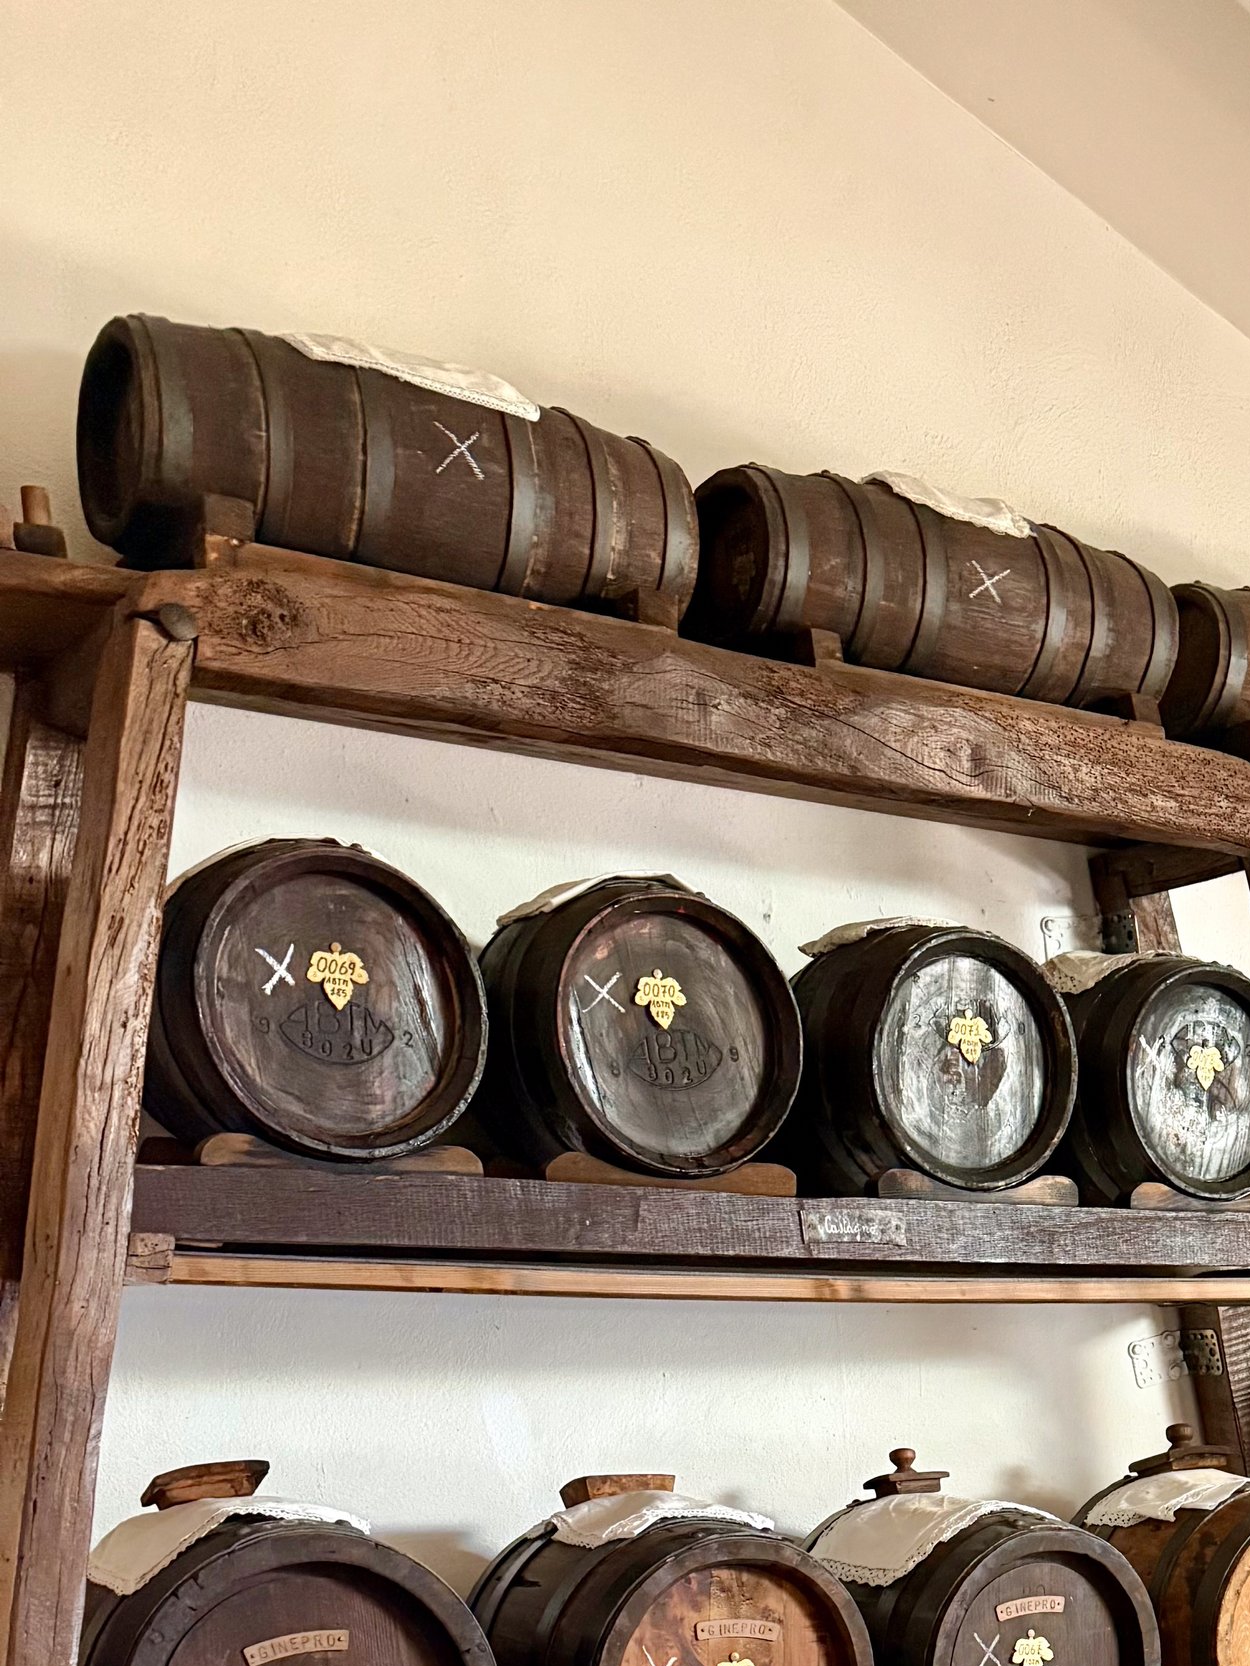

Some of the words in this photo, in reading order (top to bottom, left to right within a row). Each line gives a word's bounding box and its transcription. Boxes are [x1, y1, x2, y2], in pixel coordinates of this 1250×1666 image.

[316, 956, 356, 976] 0069
[643, 982, 676, 998] 0070
[954, 1022, 982, 1037] 0071
[1005, 1600, 1057, 1616] GINEPRO
[708, 1623, 766, 1637] GINEPRO
[258, 1634, 337, 1660] GINEPRO
